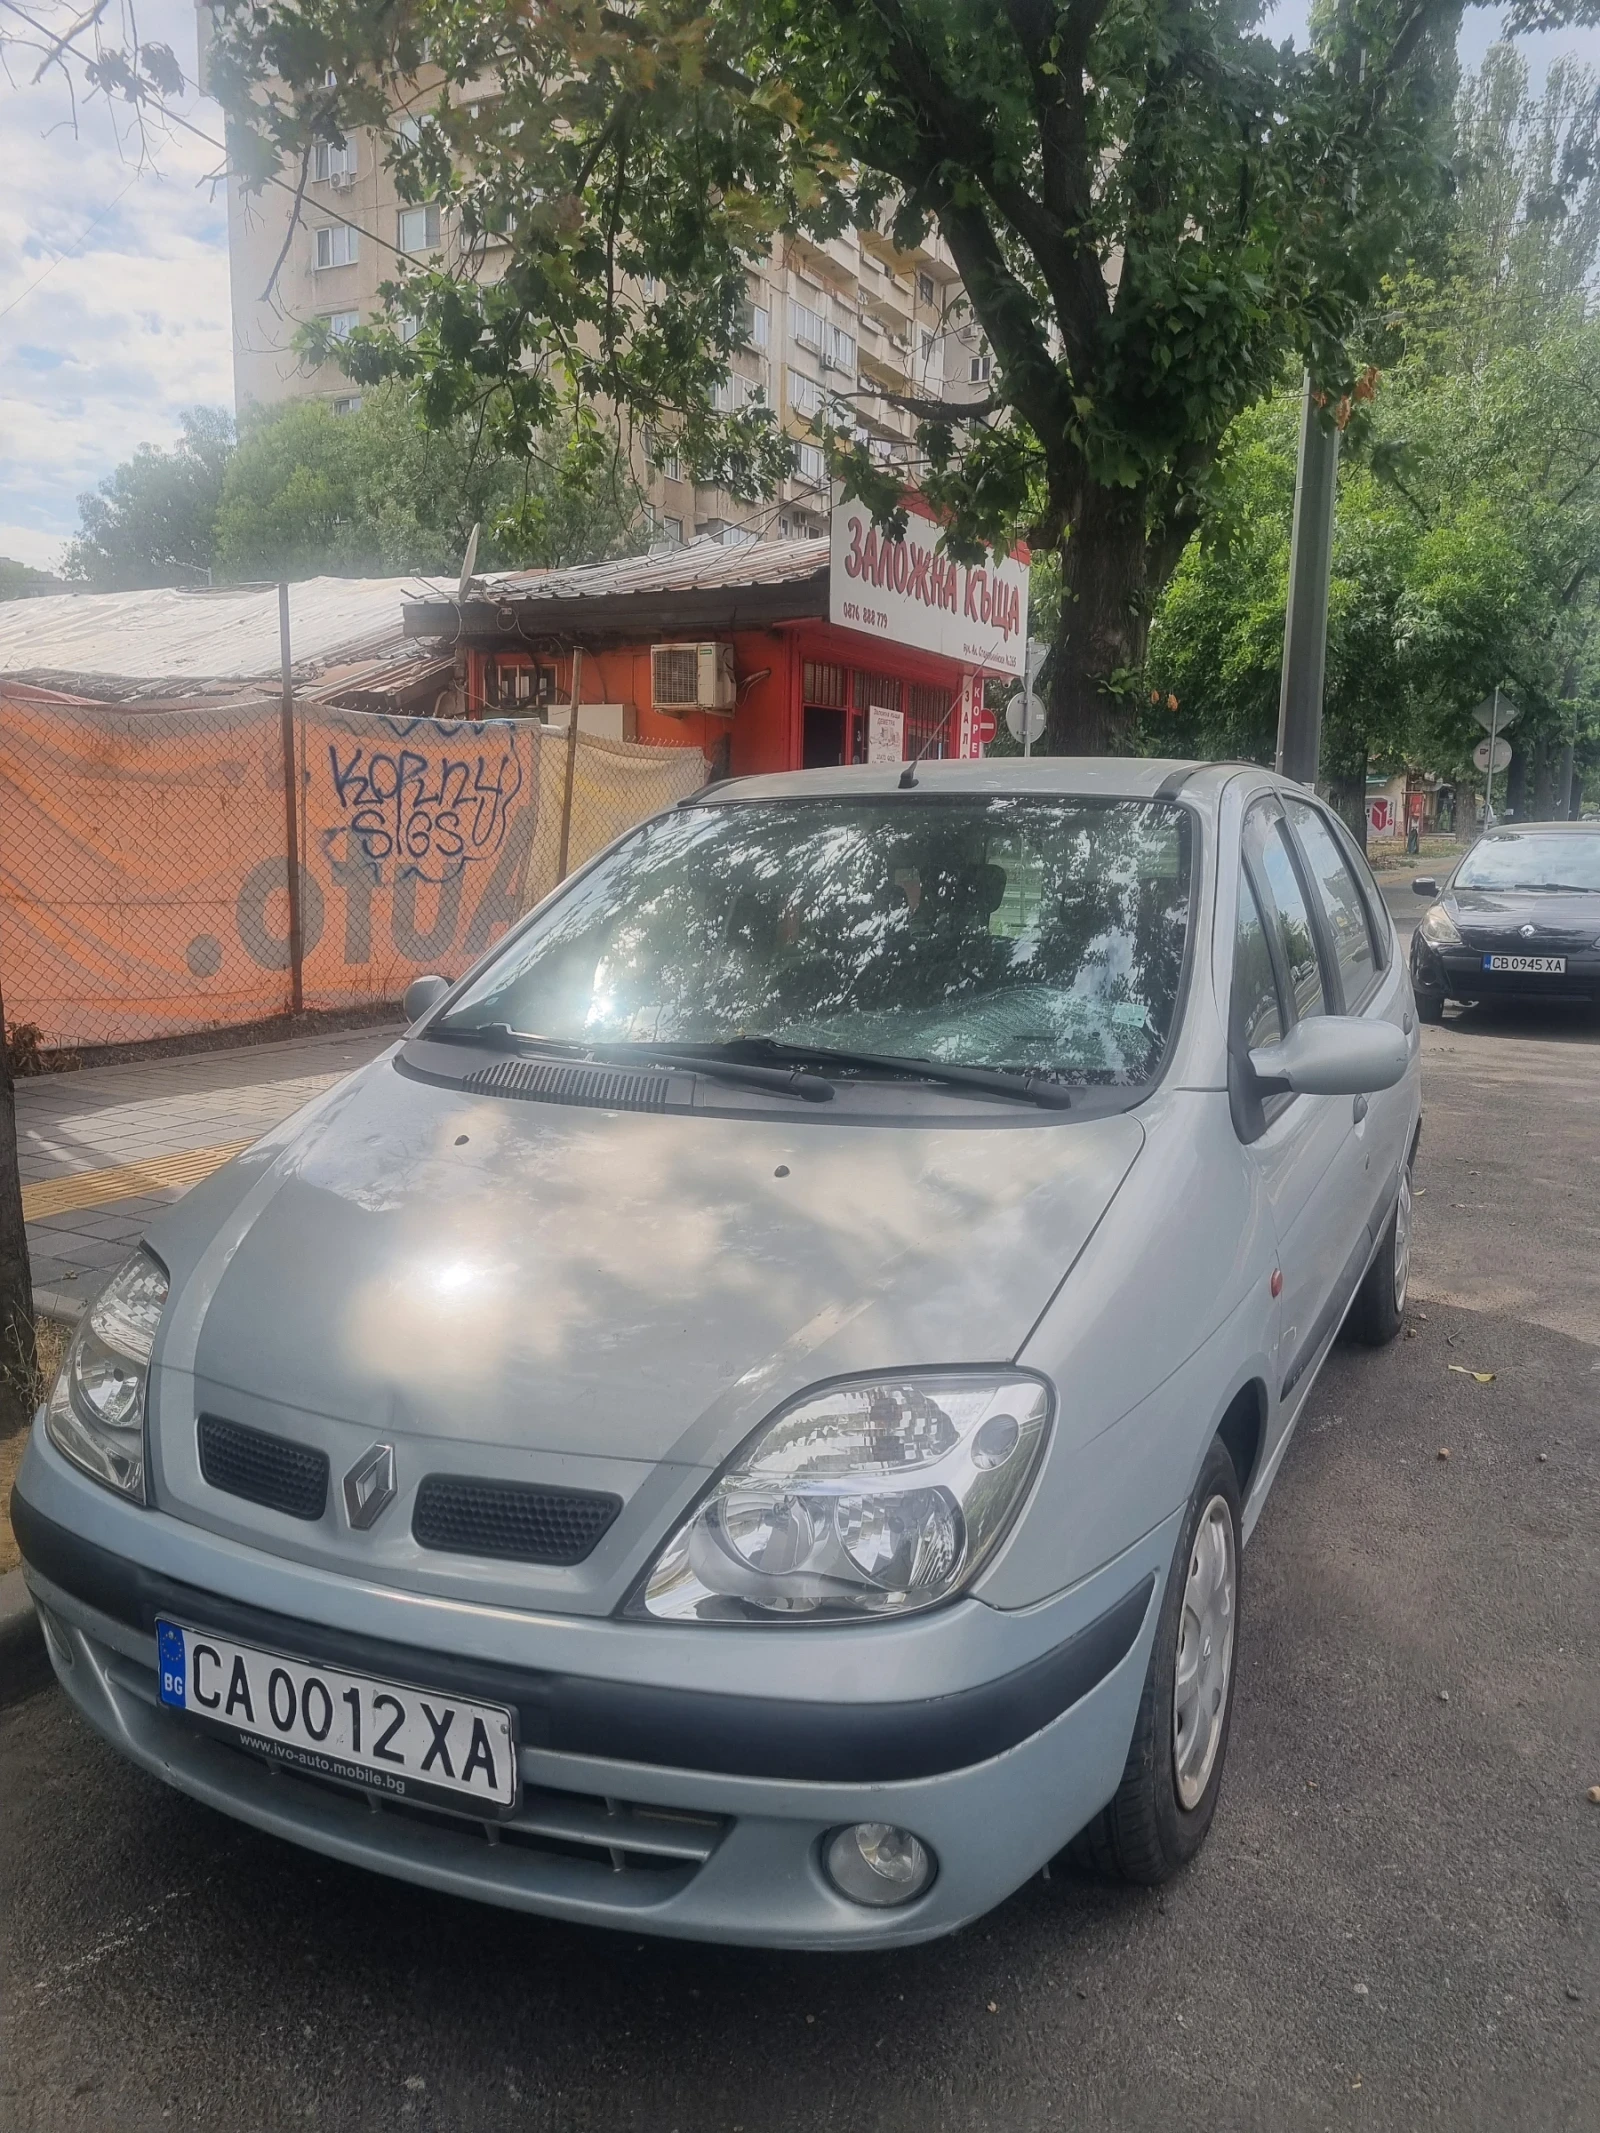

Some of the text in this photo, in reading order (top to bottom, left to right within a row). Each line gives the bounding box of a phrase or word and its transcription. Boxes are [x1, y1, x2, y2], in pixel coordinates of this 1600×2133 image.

[844, 516, 1020, 643] ЗАЛОЖНА КЪЩА
[843, 602, 888, 629] 0876 888 779
[1511, 958, 1543, 971] 0945
[1545, 959, 1562, 972] XA
[164, 1672, 184, 1696] BG
[192, 1643, 499, 1790] CA 0012 XA
[239, 1733, 406, 1795] www.ivo-auto.mobile.bg
